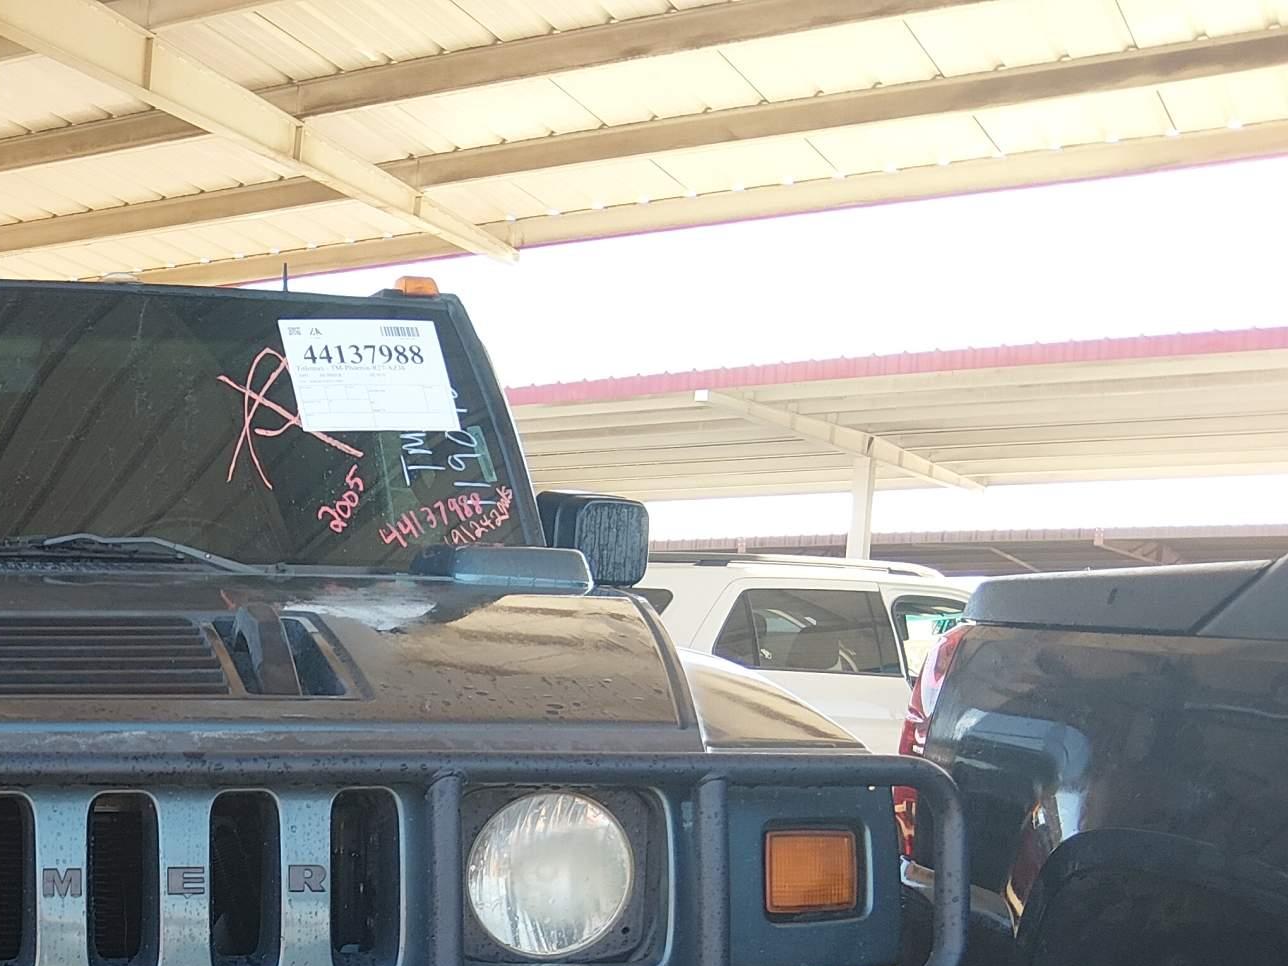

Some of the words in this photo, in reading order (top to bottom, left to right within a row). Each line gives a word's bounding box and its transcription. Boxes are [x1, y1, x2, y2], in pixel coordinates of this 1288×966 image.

[303, 344, 425, 365] 44137988
[318, 464, 364, 533] 2005
[378, 492, 483, 548] 44137988
